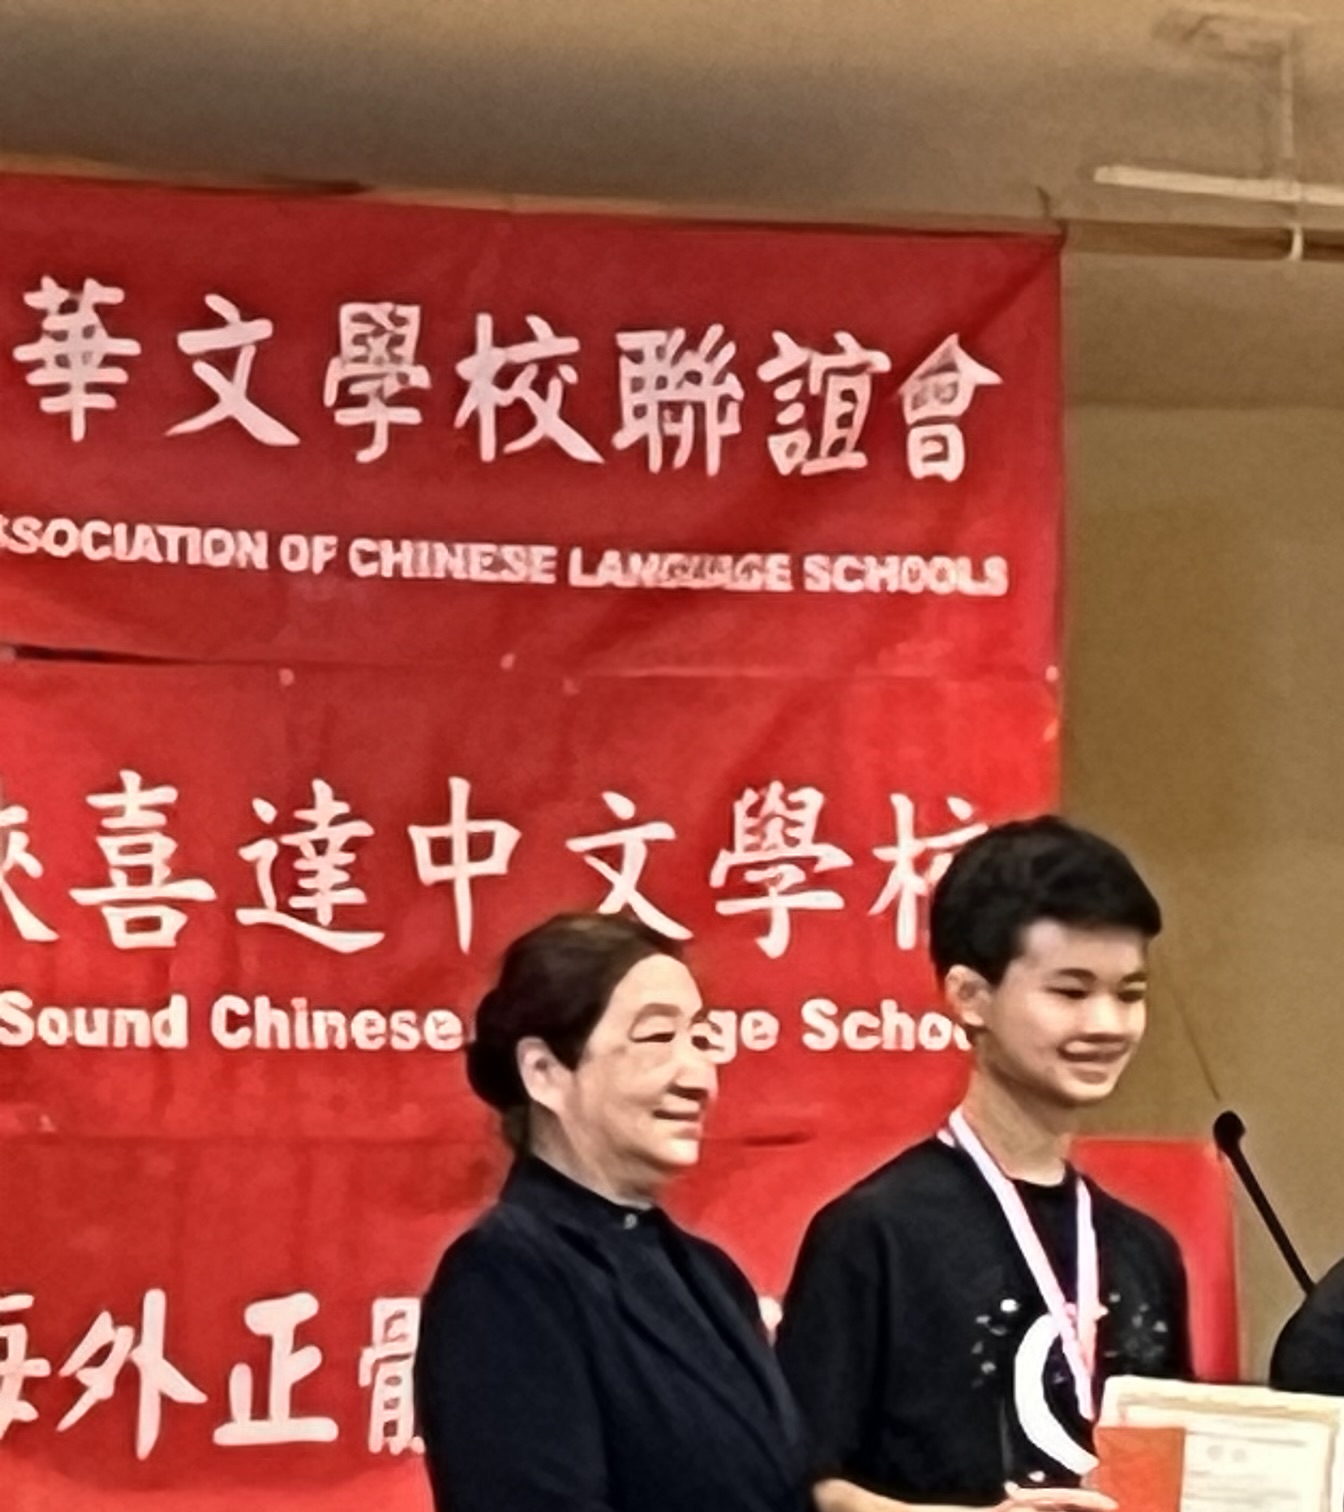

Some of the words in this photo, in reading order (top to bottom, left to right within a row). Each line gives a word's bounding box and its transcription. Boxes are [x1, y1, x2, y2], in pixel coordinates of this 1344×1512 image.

[13, 275, 1002, 482] 華文學校聯誼會
[279, 534, 338, 574] OF
[349, 538, 557, 584] CHINESE
[569, 547, 793, 592] LANGUAGE
[803, 554, 1008, 596] SCHOOLS
[0, 990, 188, 1049] Sound
[210, 994, 464, 1051] Chinese
